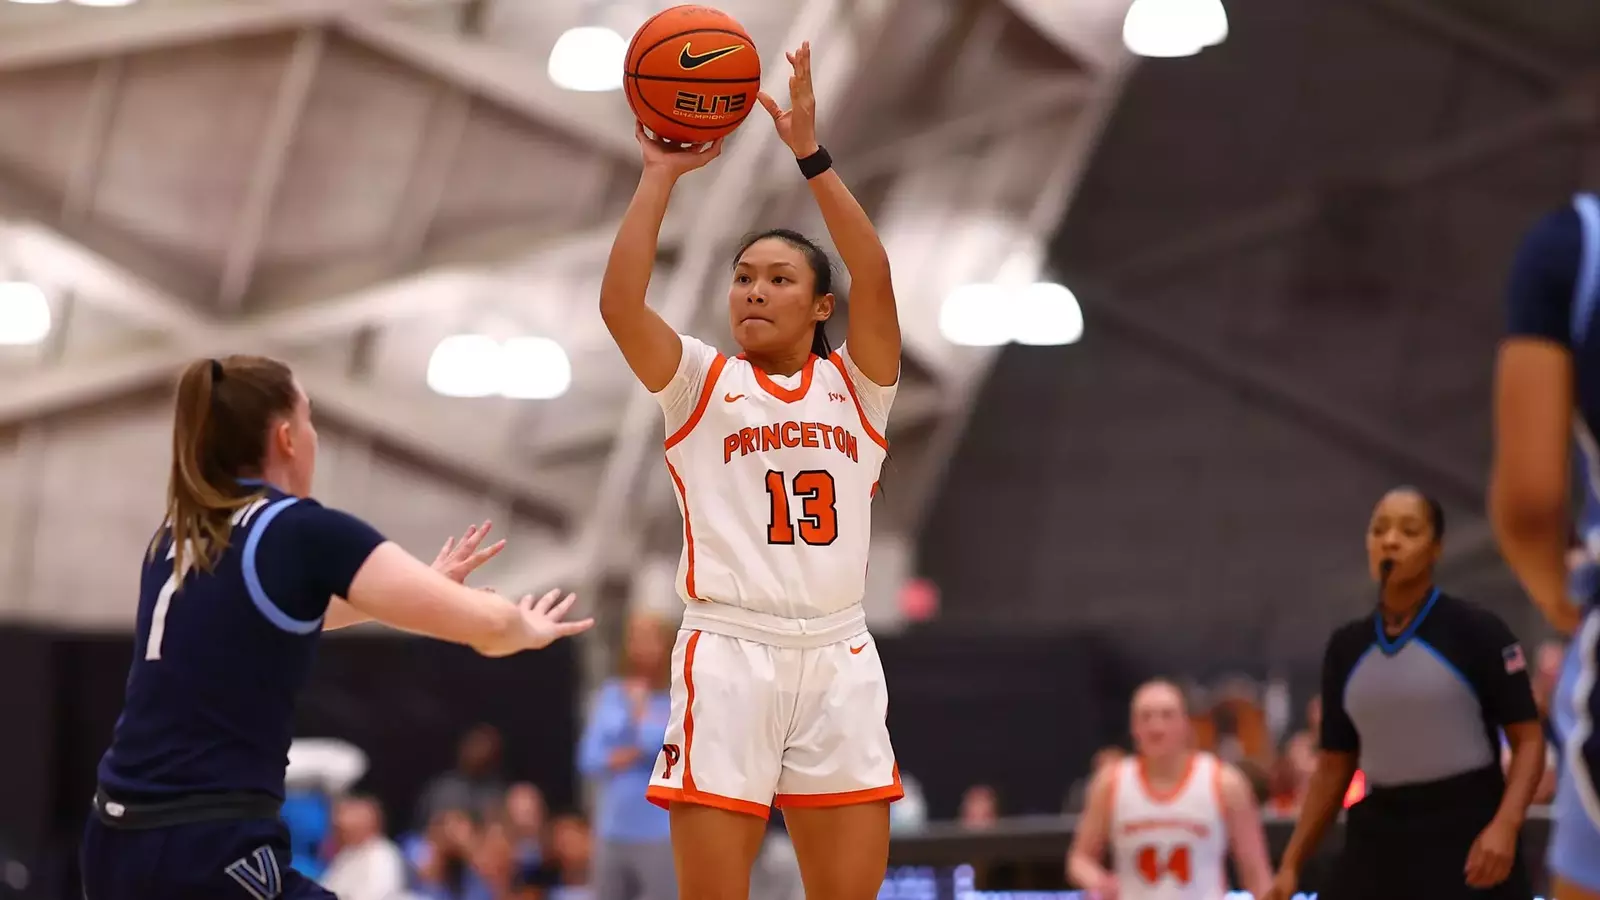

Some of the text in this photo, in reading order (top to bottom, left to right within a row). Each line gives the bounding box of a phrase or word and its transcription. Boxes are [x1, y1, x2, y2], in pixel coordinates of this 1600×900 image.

[672, 110, 725, 120] CHAMPION
[674, 90, 747, 114] ELITE
[723, 421, 858, 464] PRINCETON
[765, 469, 838, 546] 13
[662, 743, 680, 779] P
